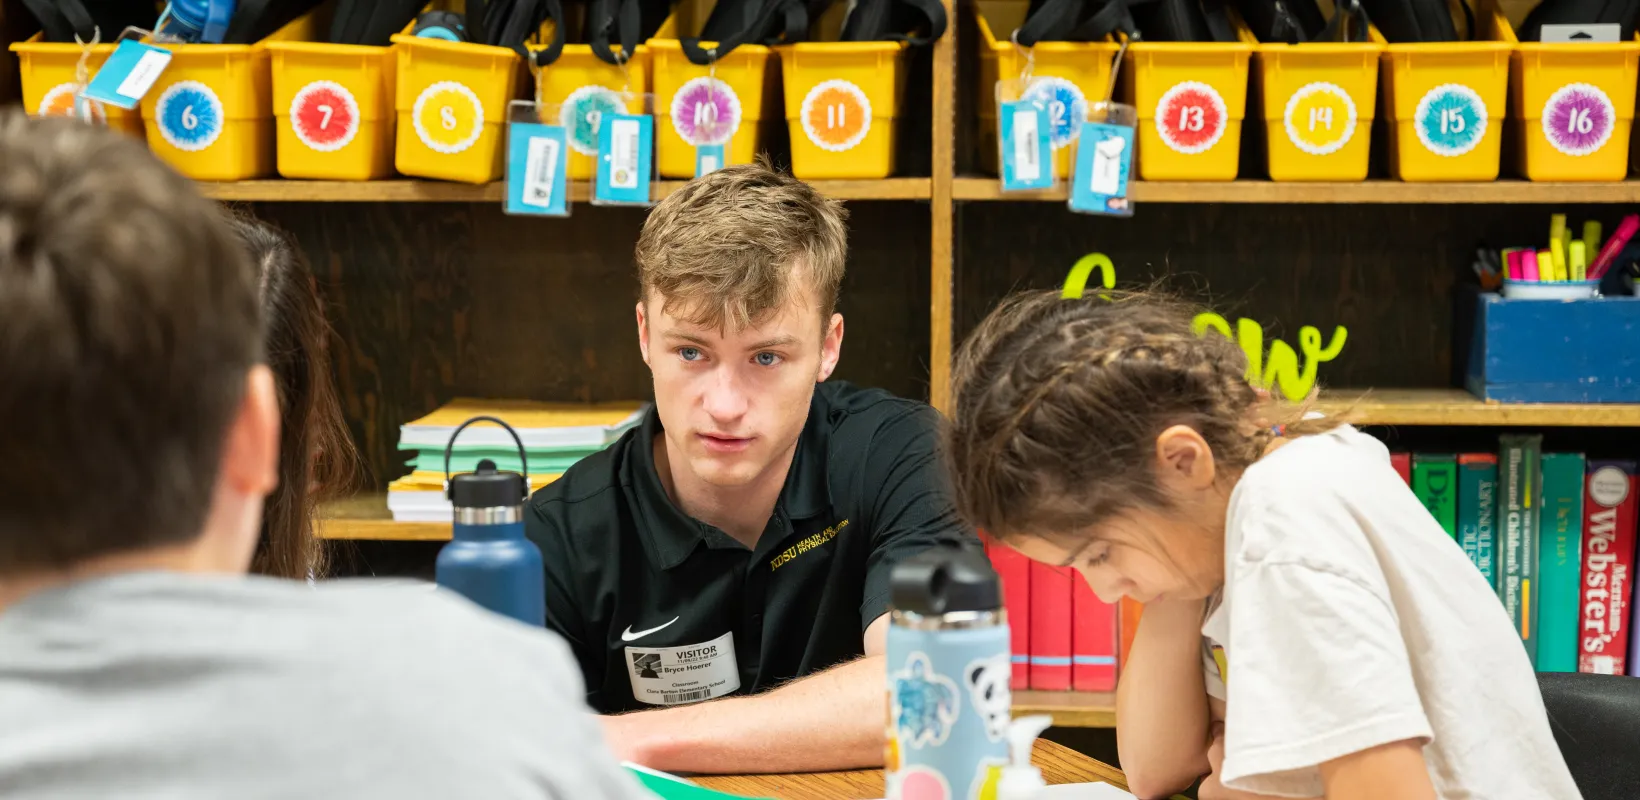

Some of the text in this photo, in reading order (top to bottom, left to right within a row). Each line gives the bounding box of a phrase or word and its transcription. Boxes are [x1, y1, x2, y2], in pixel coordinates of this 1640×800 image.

[182, 105, 198, 130] 6
[317, 105, 333, 130] 7
[440, 106, 457, 130] 8
[586, 110, 602, 135] 9
[694, 101, 718, 131] 10
[827, 103, 846, 129] 11
[1049, 100, 1067, 125] 2
[1179, 105, 1205, 132] 13
[1308, 107, 1333, 132] 14
[1440, 107, 1466, 134] 15
[1567, 107, 1594, 134] 16
[796, 526, 834, 549] HEALTH AND
[1477, 479, 1493, 577] DICTIONARY
[798, 535, 830, 555] PHYSICAL
[1463, 524, 1478, 566] STIC
[770, 546, 797, 572] NDSU
[1583, 508, 1617, 653] Webster's
[676, 645, 717, 660] VISITOR
[664, 662, 712, 674] Bryce Hoerer
[679, 684, 708, 693] Elementary
[709, 679, 726, 688] School
